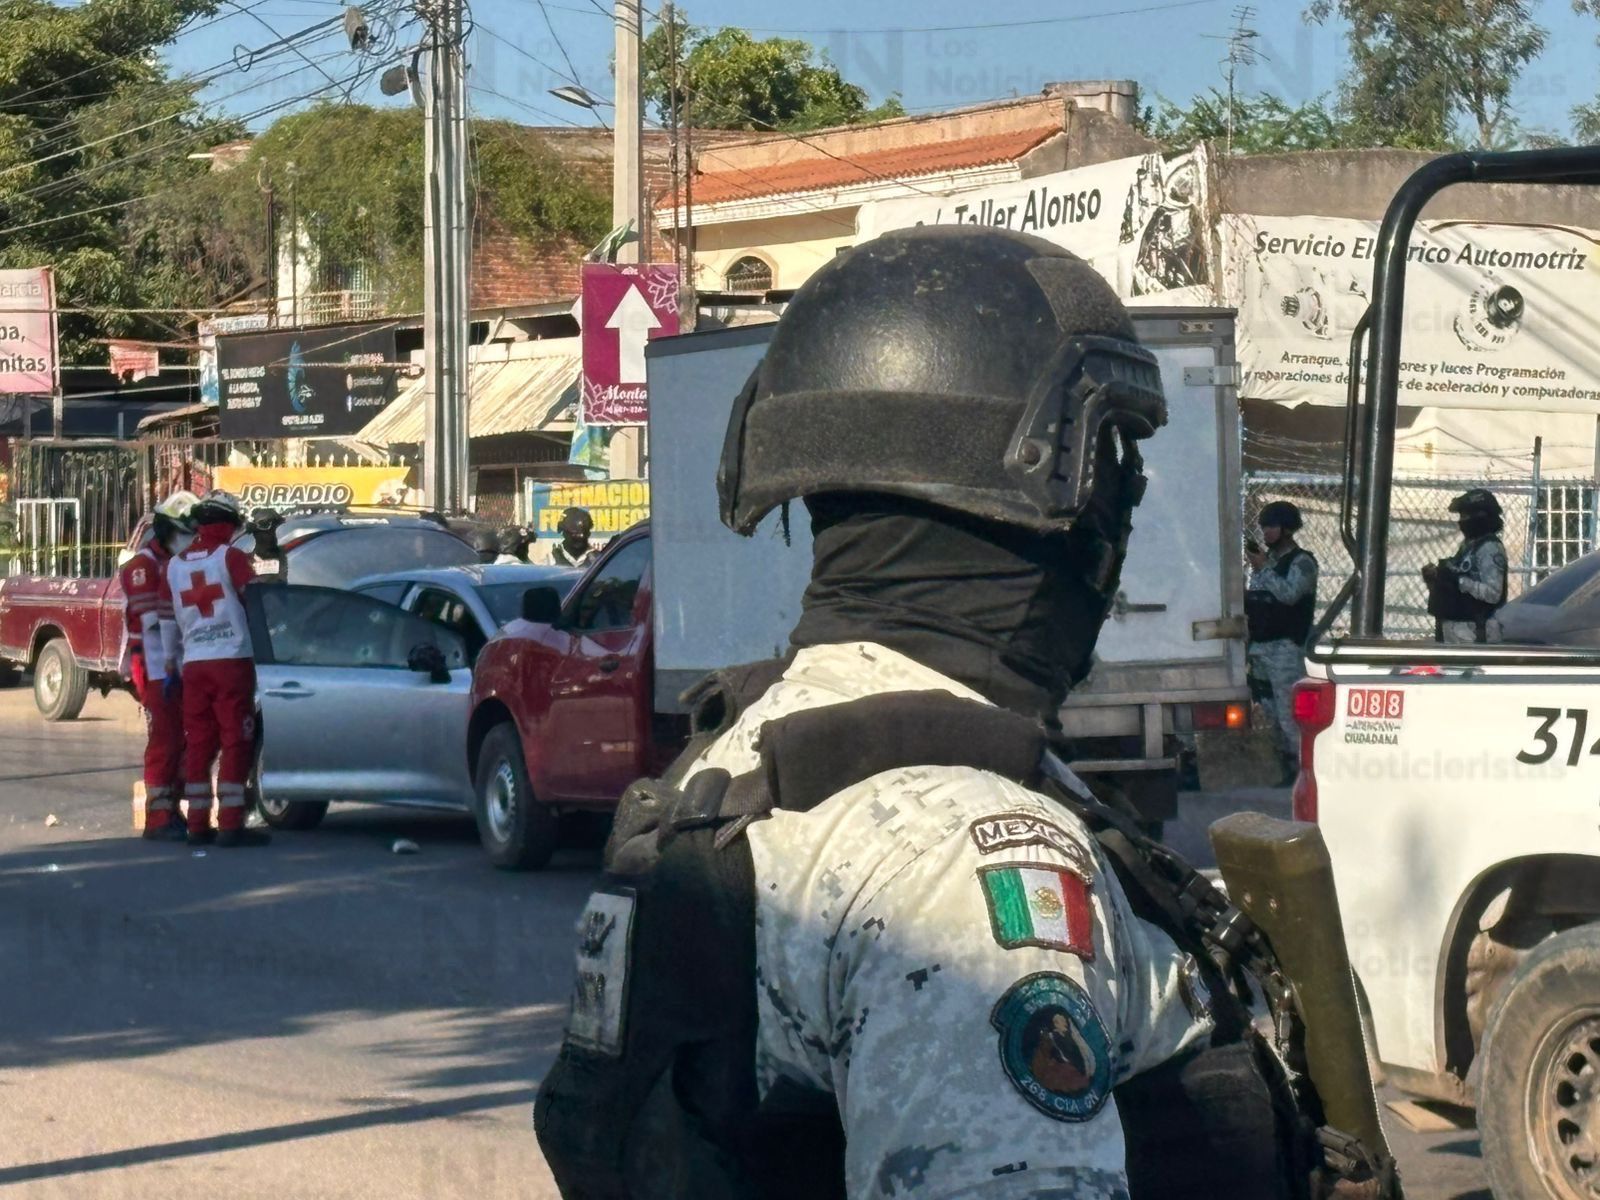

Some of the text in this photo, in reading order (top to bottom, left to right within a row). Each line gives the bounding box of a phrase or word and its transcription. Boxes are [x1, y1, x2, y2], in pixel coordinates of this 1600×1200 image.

[1020, 186, 1102, 232] Alonso
[1255, 230, 1587, 271] Servicio Elrico Automotriz
[0, 353, 47, 373] nitas
[1430, 363, 1438, 376] y
[1440, 361, 1473, 375] luces
[1476, 362, 1566, 381] Programación
[1254, 369, 1332, 384] reparaciones
[1406, 378, 1423, 391] de
[1425, 379, 1499, 394] aceleración
[1501, 385, 1510, 398] y
[240, 484, 352, 505] JG RADIO
[1350, 692, 1401, 717] 088
[1344, 732, 1399, 745] CIUDADANA
